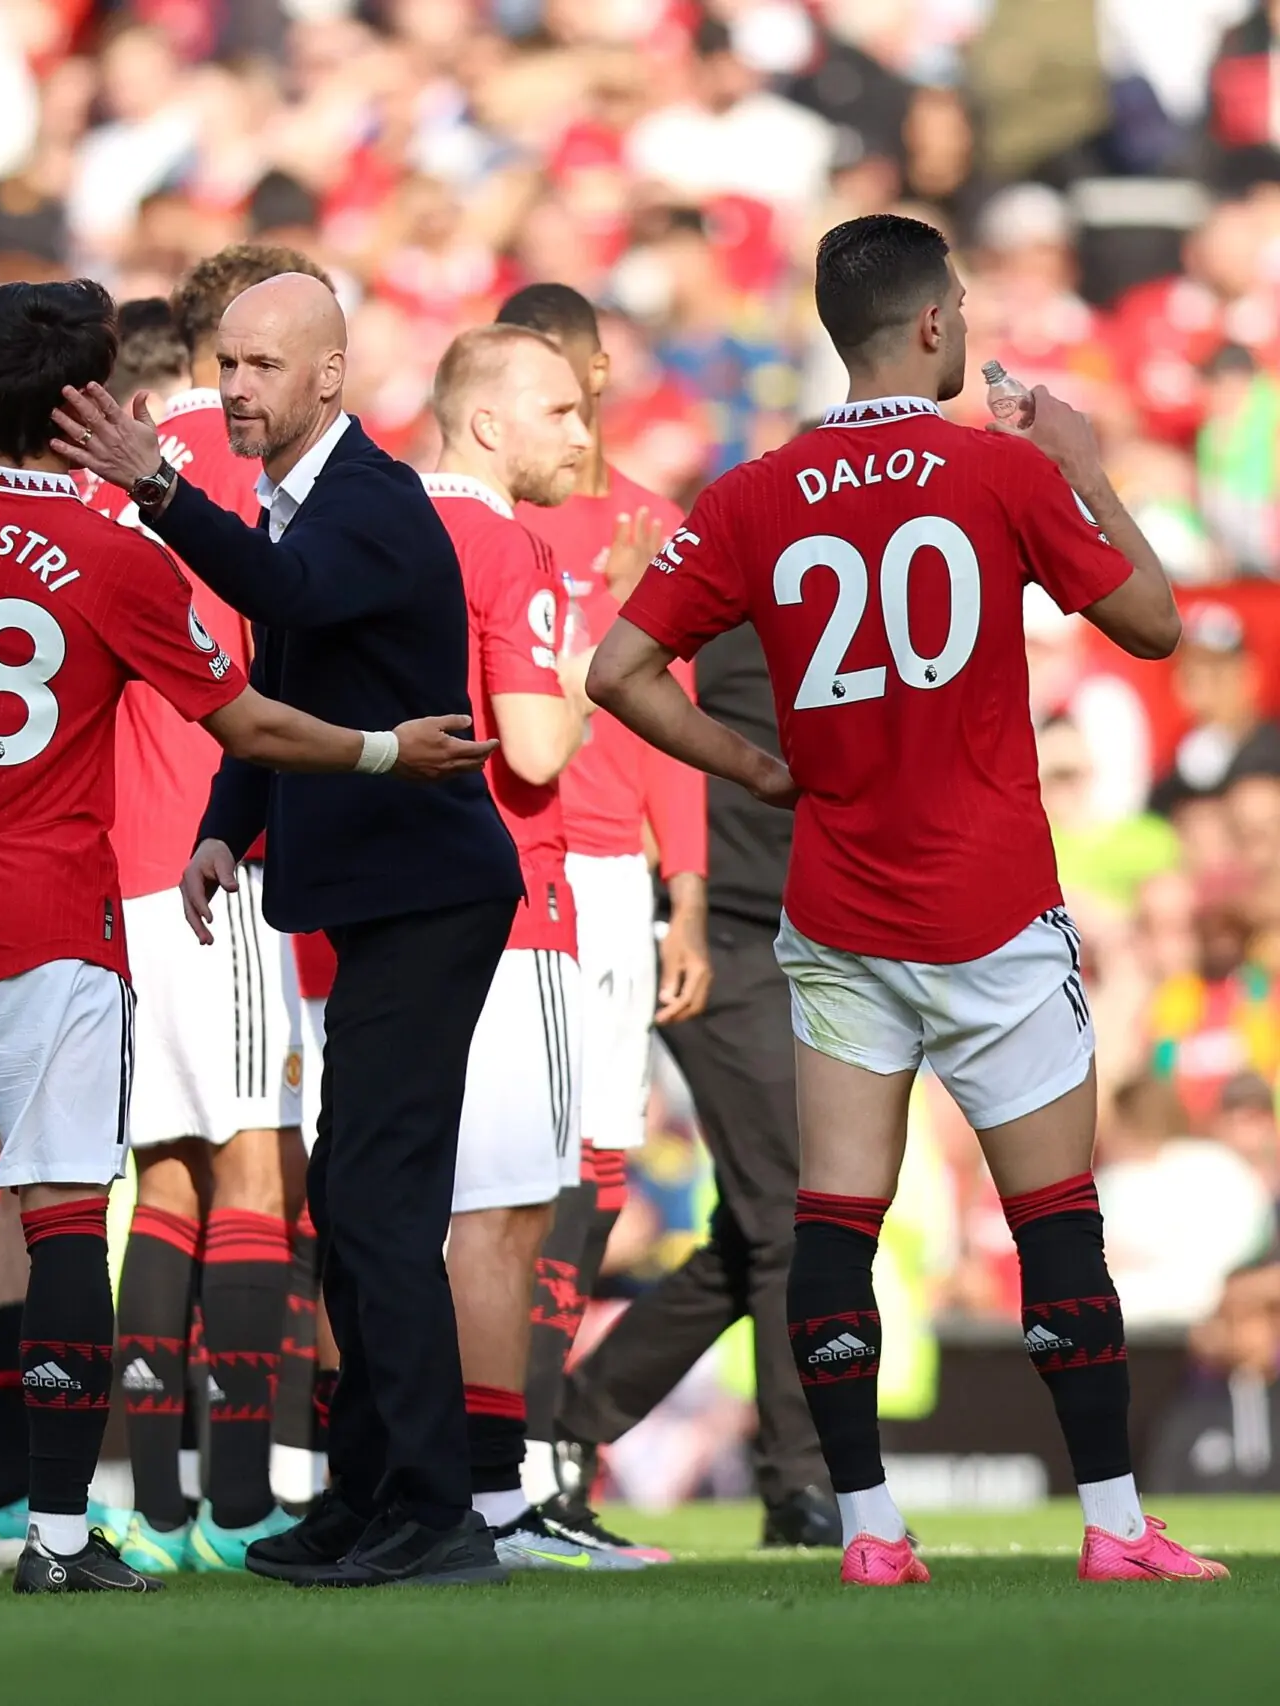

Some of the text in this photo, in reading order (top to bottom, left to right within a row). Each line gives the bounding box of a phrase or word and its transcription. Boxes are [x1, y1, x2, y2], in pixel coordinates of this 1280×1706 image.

[796, 448, 946, 504] DALOT
[773, 515, 981, 710] 20
[807, 1346, 876, 1363] adidas
[22, 1376, 82, 1390] adidas
